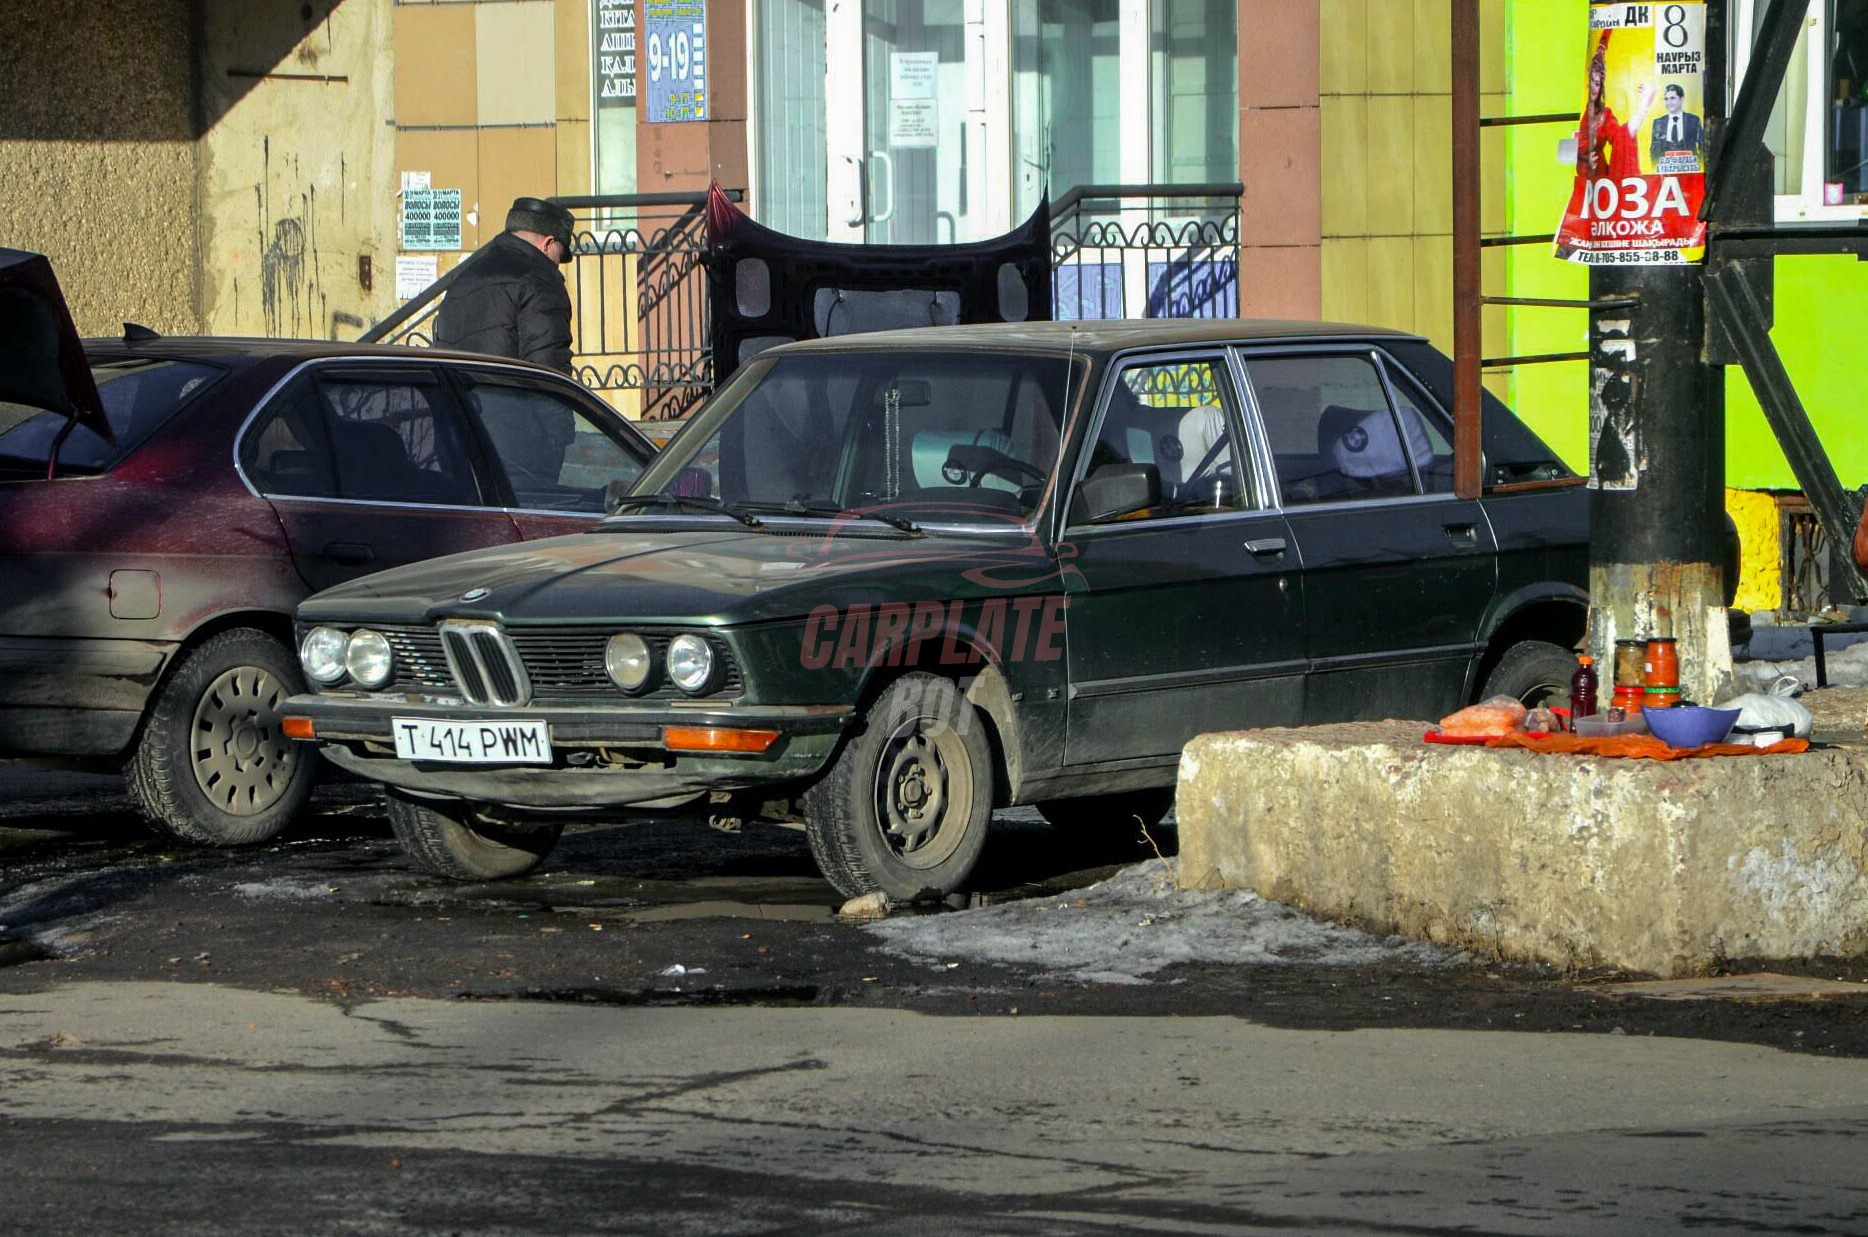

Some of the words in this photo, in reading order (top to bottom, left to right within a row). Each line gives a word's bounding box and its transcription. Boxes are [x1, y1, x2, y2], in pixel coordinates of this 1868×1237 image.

[1625, 6, 1649, 26] ДК
[1663, 4, 1688, 48] 8
[648, 30, 690, 82] 9-19
[1656, 51, 1701, 63] НАУРЫЗ
[1661, 63, 1697, 75] МАРТА
[405, 212, 431, 220] 400000
[433, 211, 460, 220] 400000
[401, 724, 418, 755] T
[430, 726, 472, 757] 414
[480, 727, 542, 757] PWM
